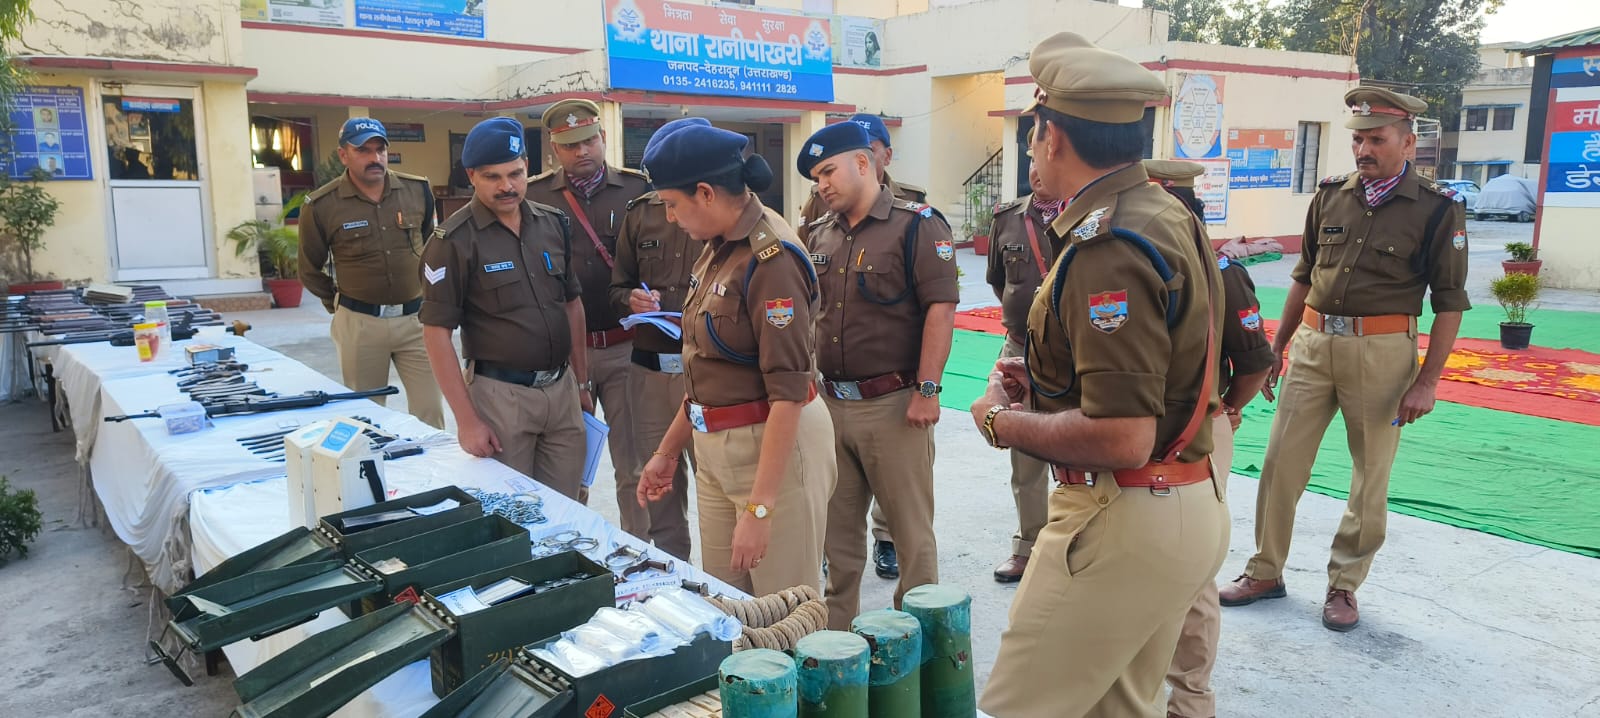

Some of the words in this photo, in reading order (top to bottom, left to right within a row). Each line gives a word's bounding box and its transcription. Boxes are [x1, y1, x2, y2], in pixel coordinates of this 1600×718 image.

[662, 3, 692, 21] मित्रता
[718, 10, 736, 25] सेवा
[761, 18, 785, 34] सुरक्षा
[650, 30, 700, 57] थाना
[703, 27, 803, 66] रानीपोखरी
[663, 75, 692, 86] 0135-
[776, 83, 797, 94] 2826
[355, 122, 381, 132] POLICE
